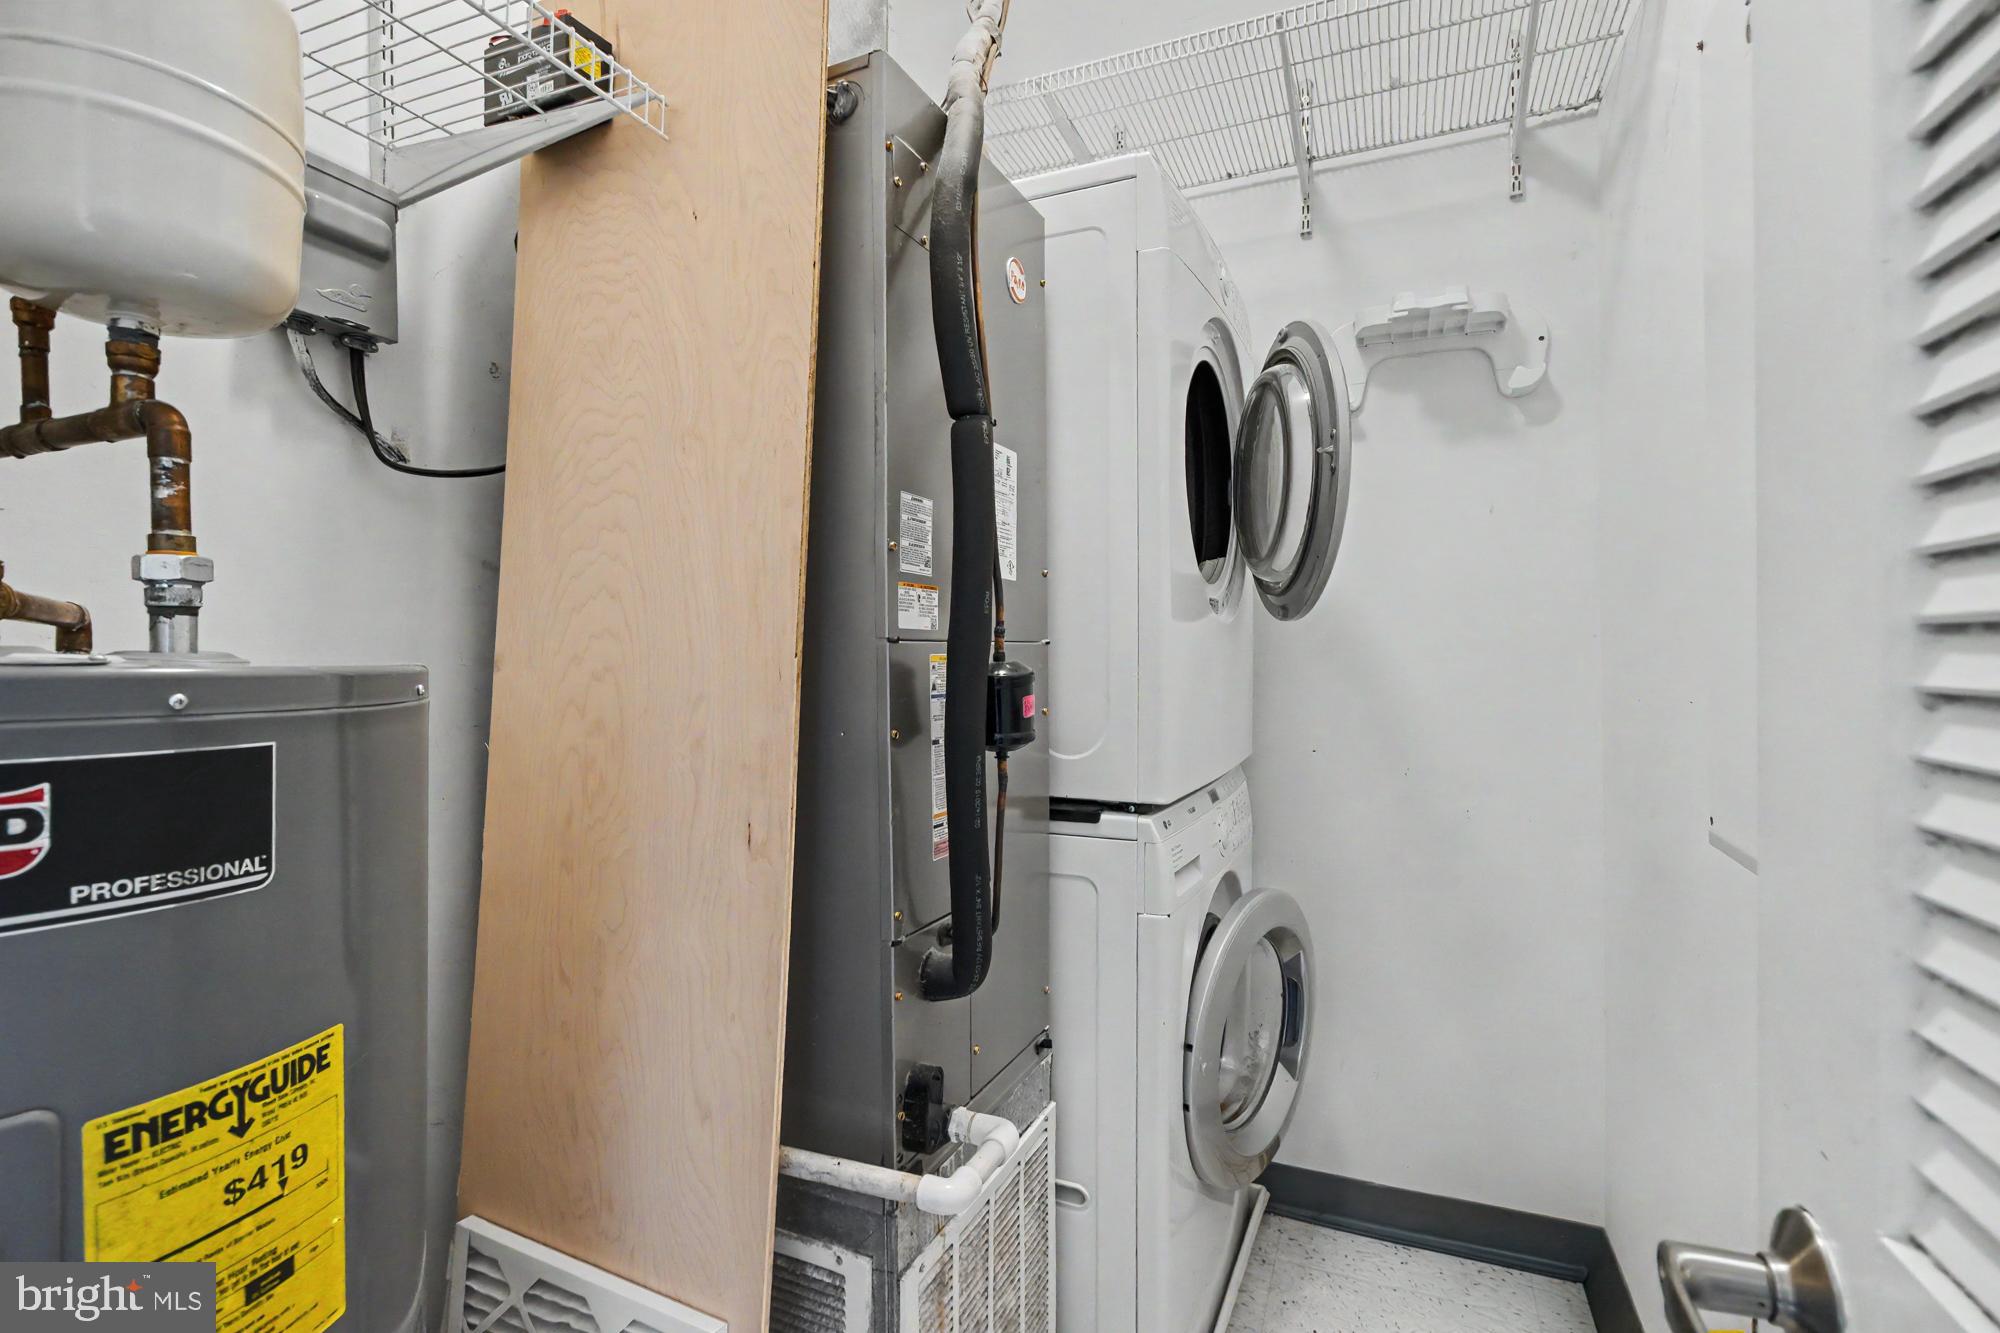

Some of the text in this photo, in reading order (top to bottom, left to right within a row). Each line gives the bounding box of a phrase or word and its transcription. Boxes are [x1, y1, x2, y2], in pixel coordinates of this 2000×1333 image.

[70, 856, 267, 904] PROFESSIONAL
[103, 1042, 331, 1164] ENERGYGUIDE
[159, 1167, 209, 1200] Estimated
[244, 1141, 272, 1163] Energy
[223, 1142, 309, 1207] $419
